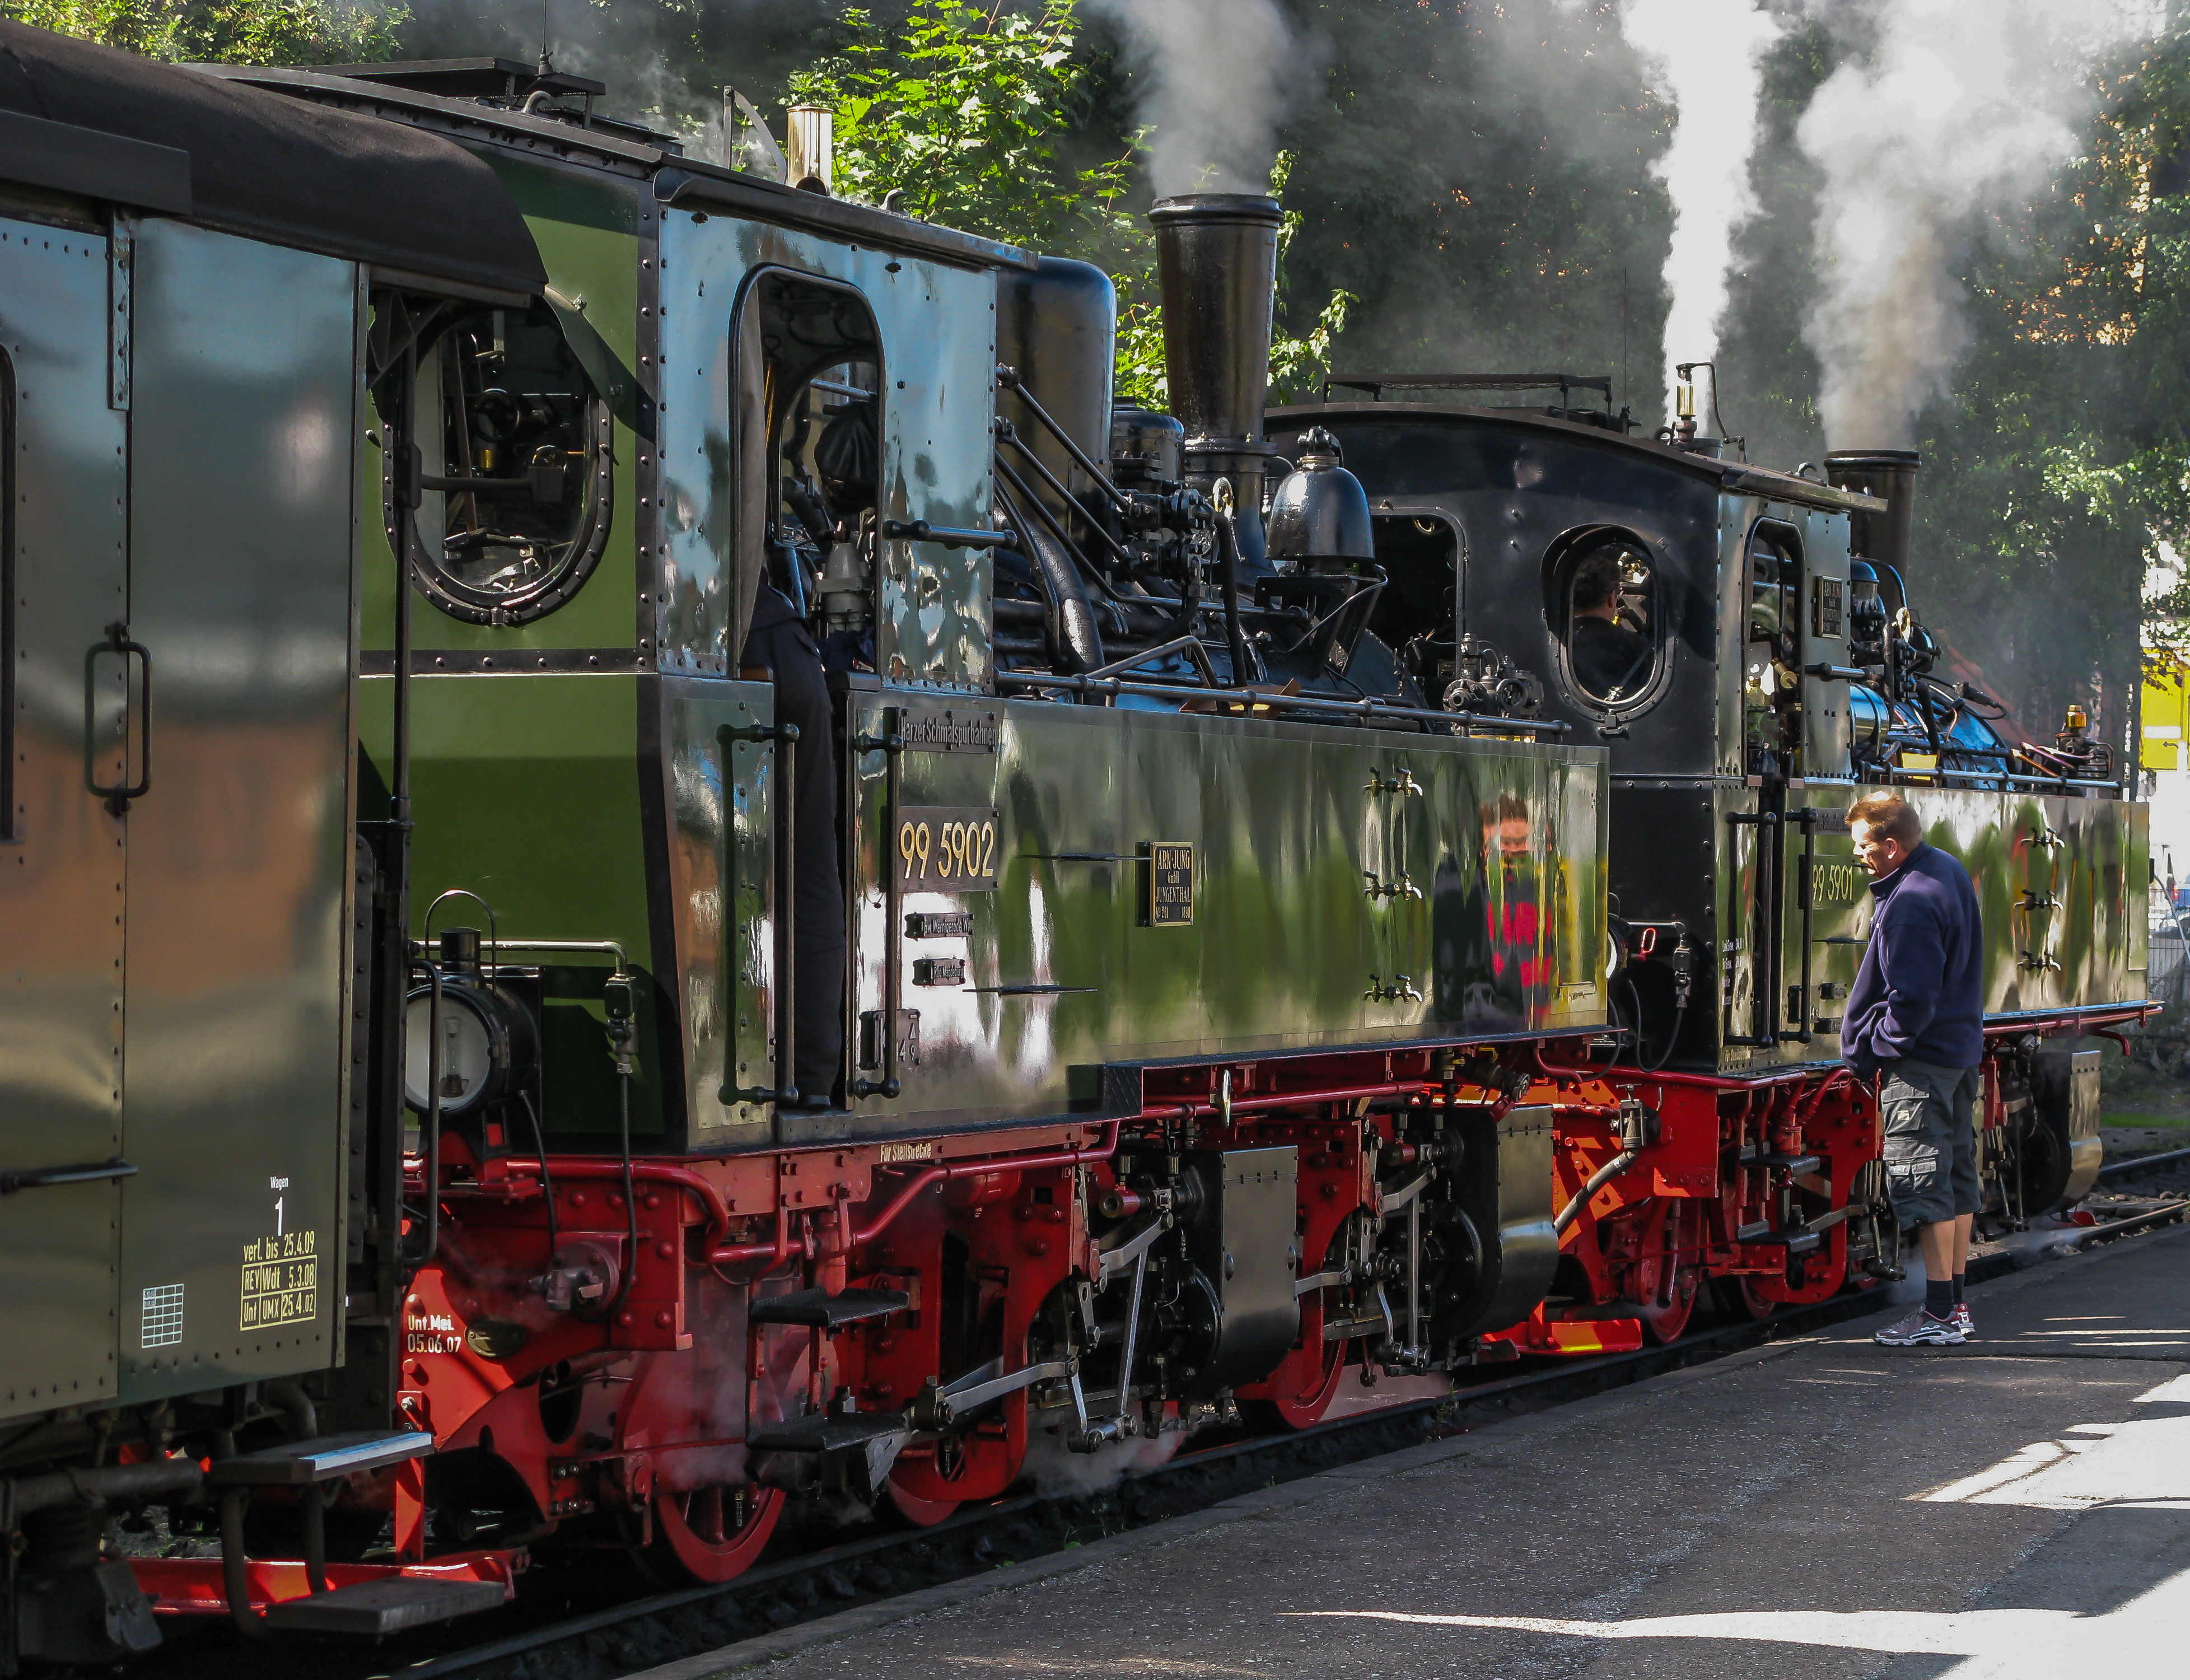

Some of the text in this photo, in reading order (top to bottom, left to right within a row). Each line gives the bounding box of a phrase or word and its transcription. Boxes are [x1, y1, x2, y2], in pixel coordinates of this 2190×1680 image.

[900, 821, 994, 879] 99 5902
[1156, 886, 1191, 903] JUNGENTHAL
[1813, 864, 1853, 902] 99 5901
[880, 1142, 931, 1163] Für Steilstrecke
[270, 1176, 289, 1191] Wagen
[274, 1196, 283, 1236] 1
[244, 1230, 315, 1262] verl. bis 25.4.09
[263, 1266, 280, 1290] Wdt
[288, 1263, 314, 1289] 5.3.08
[263, 1298, 279, 1320] UMX
[282, 1292, 314, 1317] 25.4.02
[407, 1333, 461, 1354] 05.06.07
